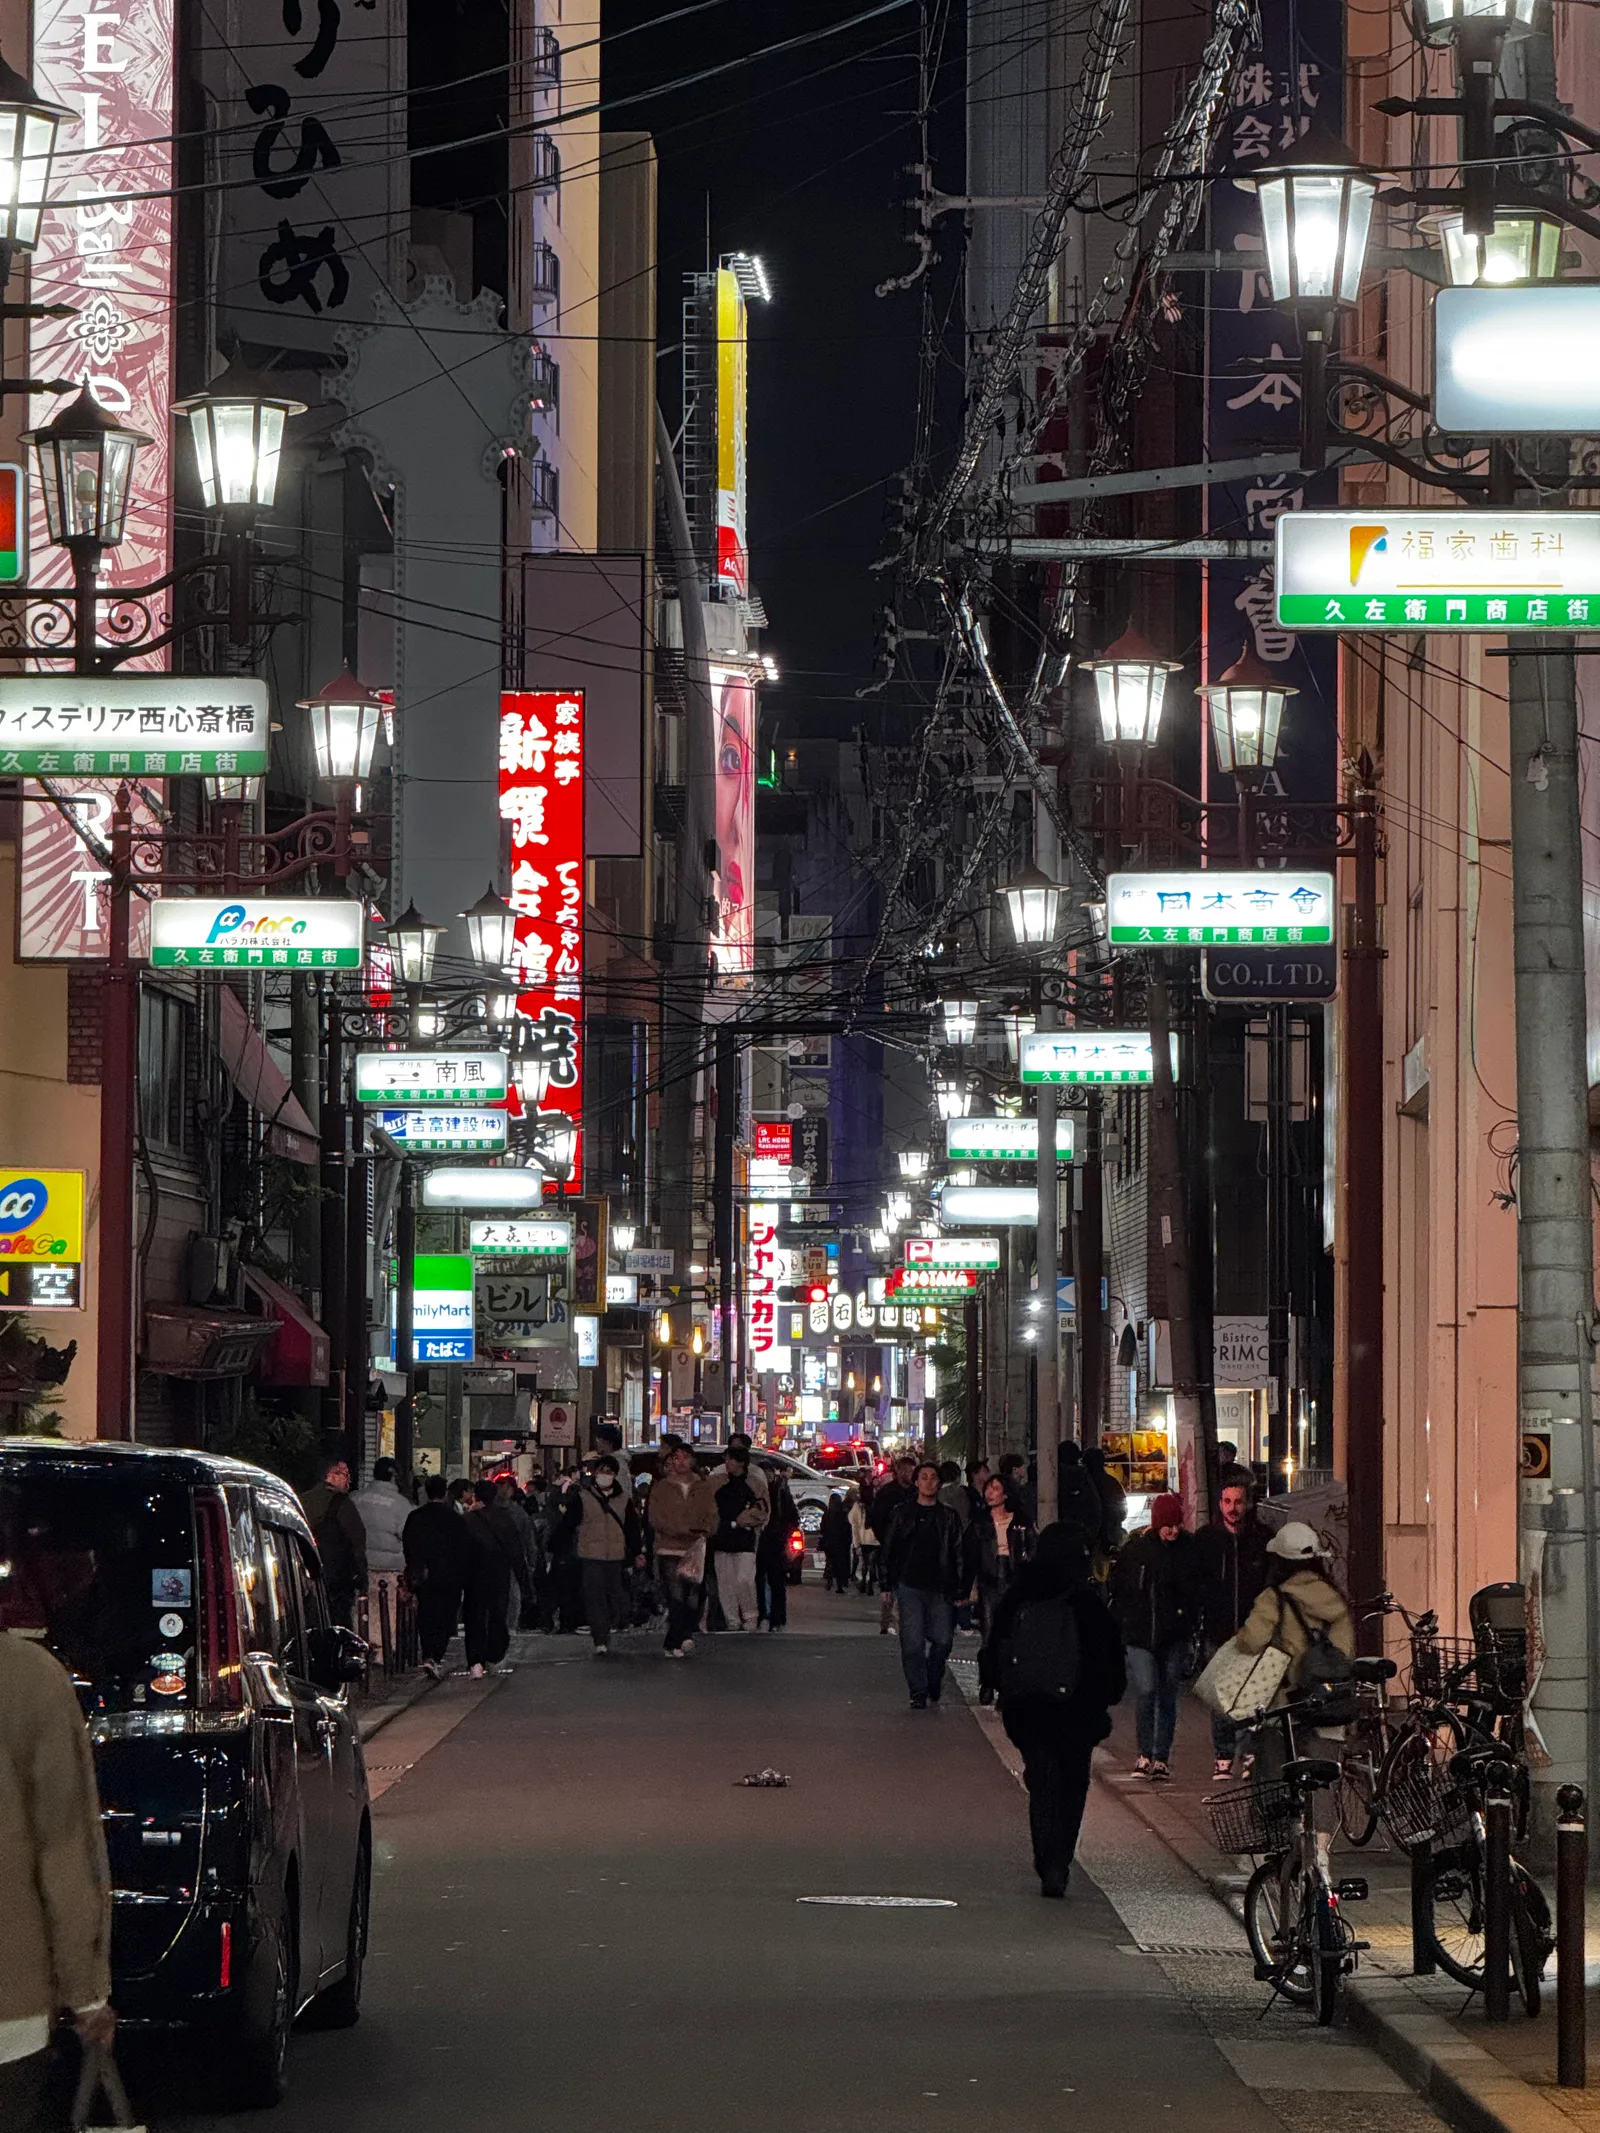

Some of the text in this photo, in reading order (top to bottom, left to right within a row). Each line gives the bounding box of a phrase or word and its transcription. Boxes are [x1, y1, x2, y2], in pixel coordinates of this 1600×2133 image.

[1401, 530, 1565, 561] 福家歯科
[1325, 600, 1590, 621] 久左衛門商店街
[0, 705, 255, 734] ィステリア西心斎橋
[554, 700, 580, 785] 家族亭
[2, 753, 237, 772] 久左衛門商店街
[1139, 928, 1303, 942] 久左衛門商店街
[174, 949, 337, 963] 久左衛門商店街
[435, 1060, 485, 1083] 南風
[377, 1090, 487, 1099] 久左衛門商店街
[396, 1140, 493, 1149] 左衛門商店街
[32, 1263, 74, 1305] 空
[902, 1270, 967, 1287] SPOTAKA
[1223, 1332, 1259, 1342] Bistro
[427, 1343, 465, 1357] たばこ
